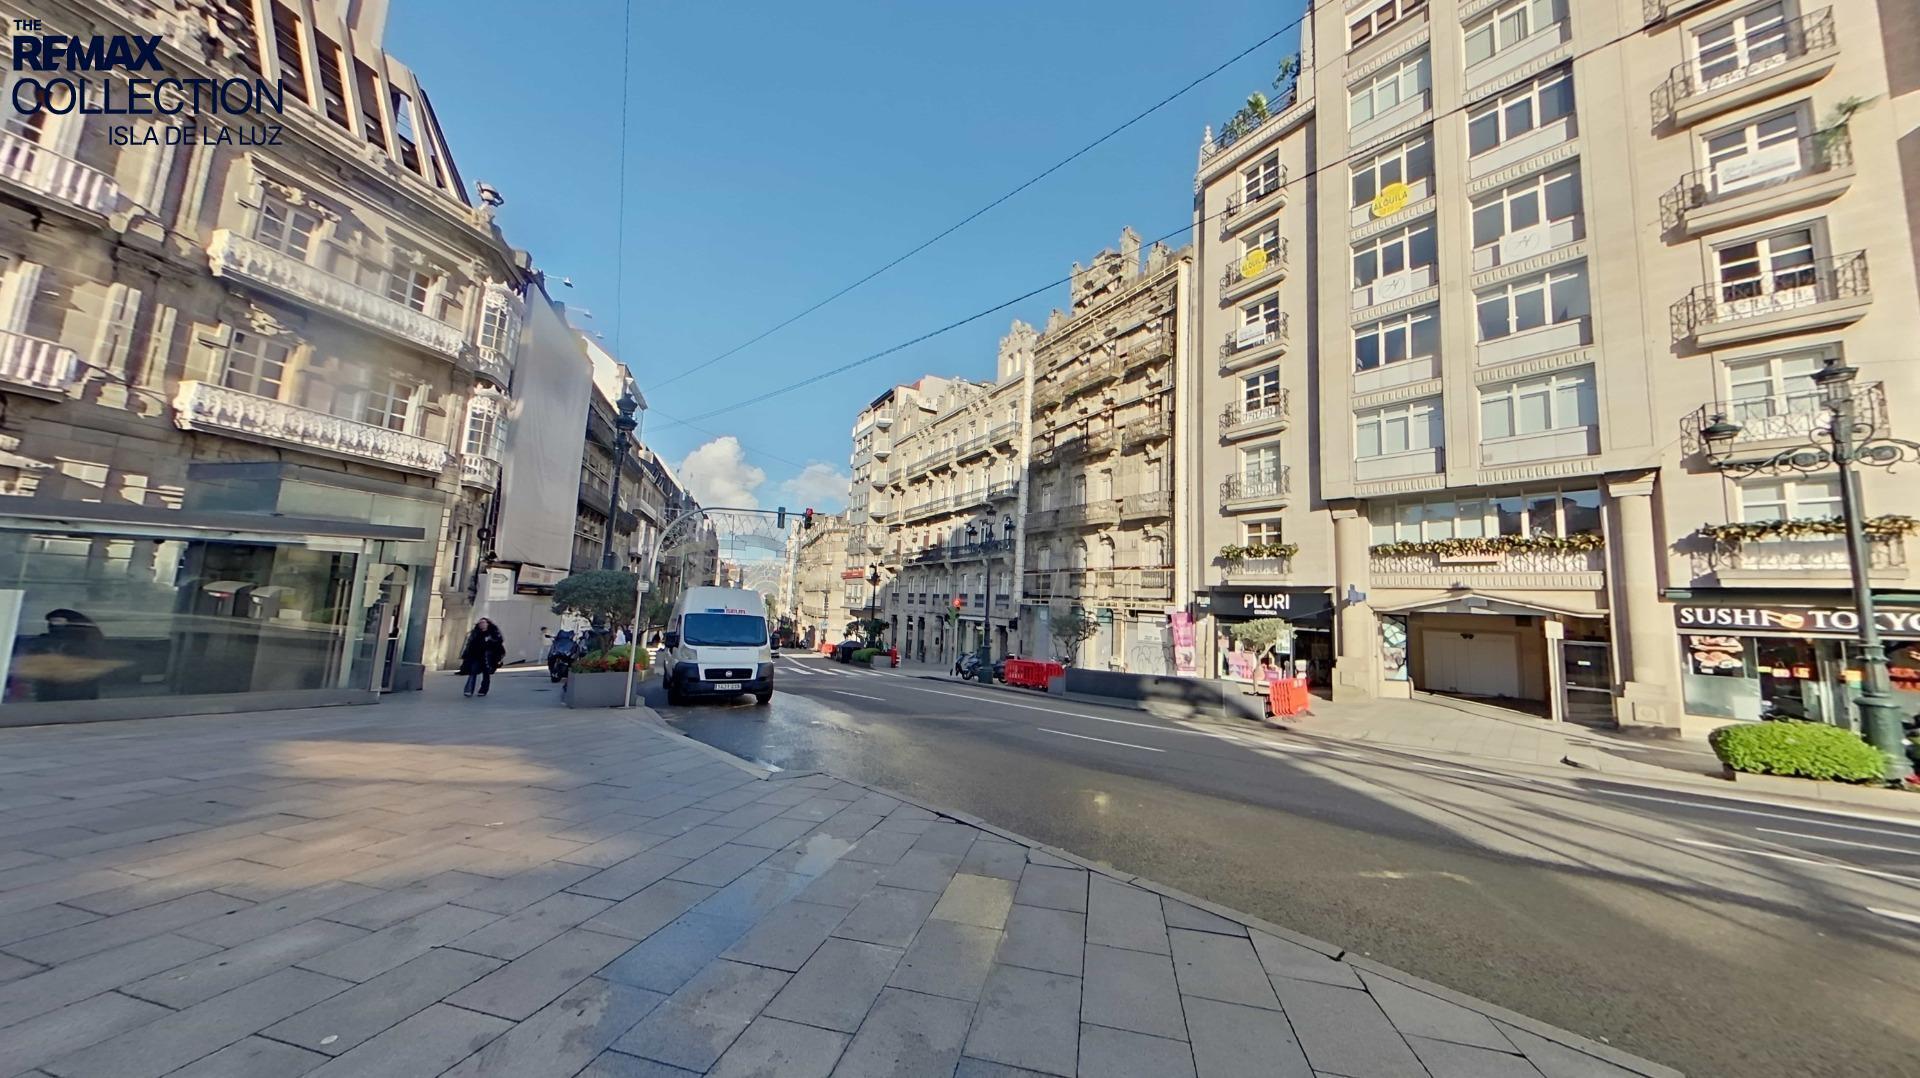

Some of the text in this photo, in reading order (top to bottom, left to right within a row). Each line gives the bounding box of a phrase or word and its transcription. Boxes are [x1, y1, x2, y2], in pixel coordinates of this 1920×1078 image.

[1373, 190, 1408, 211] ALQUILA
[1243, 593, 1290, 610] PLURI
[1680, 607, 1771, 625] SUSHI
